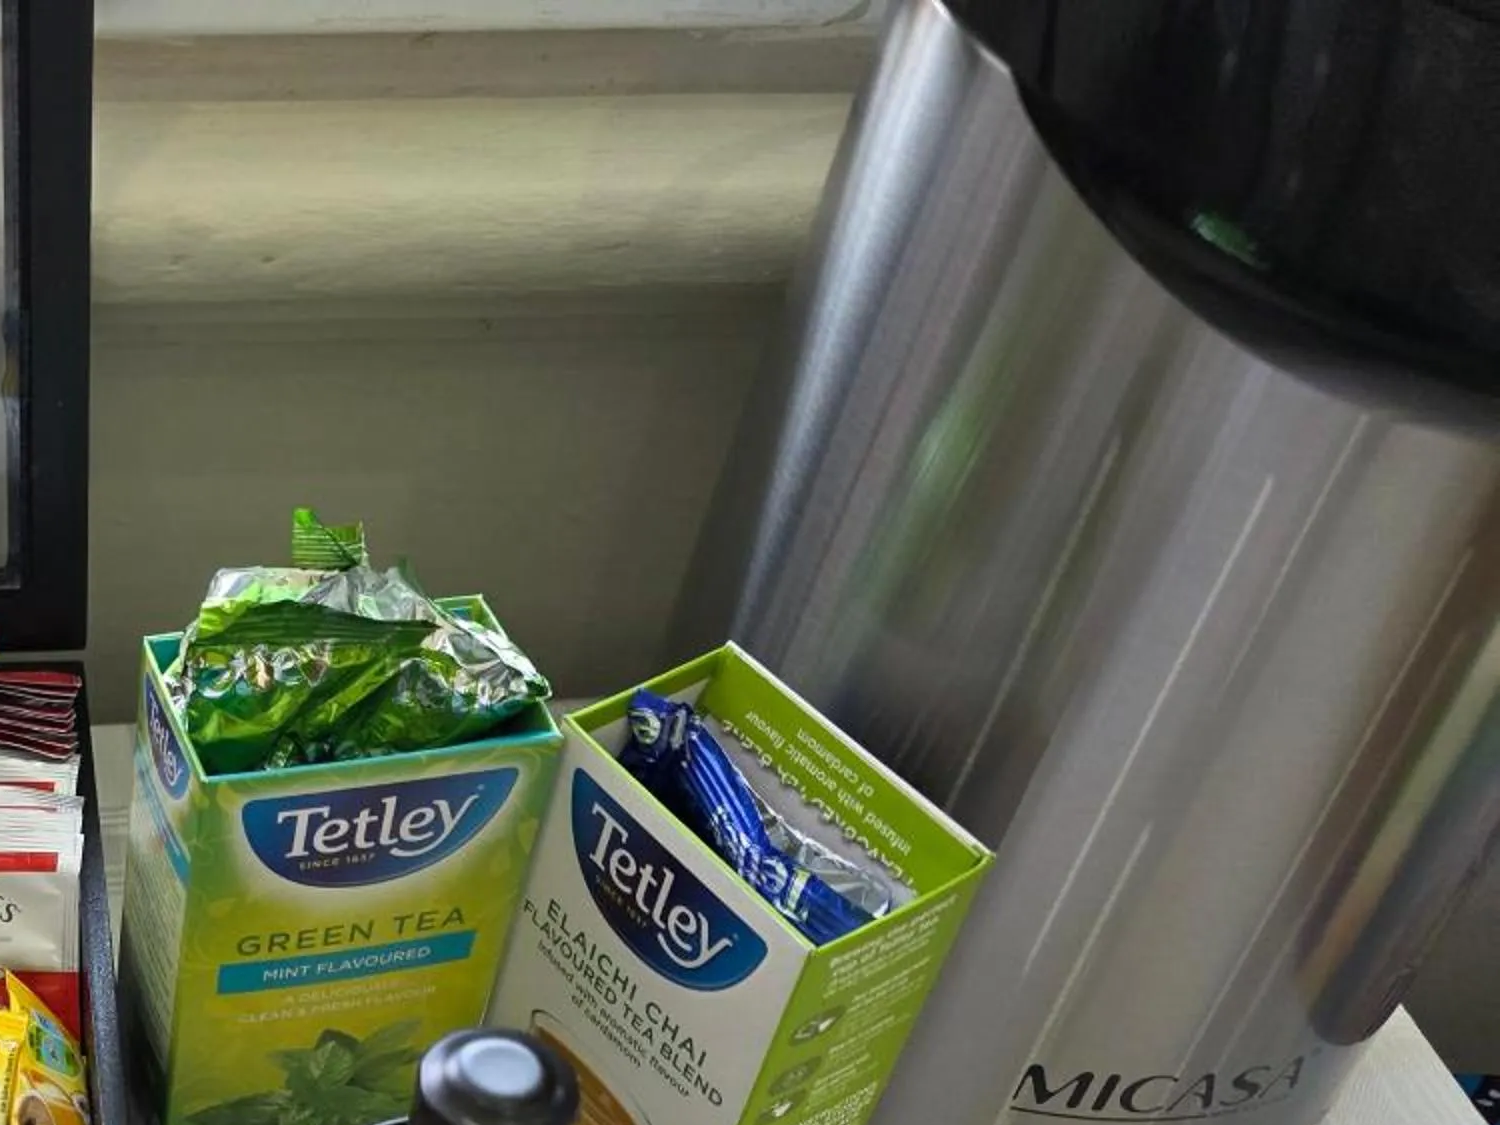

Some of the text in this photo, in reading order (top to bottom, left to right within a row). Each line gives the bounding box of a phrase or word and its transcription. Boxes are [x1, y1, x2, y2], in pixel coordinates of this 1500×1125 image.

[277, 794, 481, 859] Tetley
[589, 801, 734, 969] Tetley
[237, 906, 465, 958] GREEN TEA
[262, 946, 432, 982] MINT FLAVOURED
[523, 899, 723, 1107] FLAVOURED TEA BLEND
[547, 898, 637, 1000] ELAICHI
[645, 1002, 706, 1068] CHAI
[1011, 1055, 1307, 1114] MICASA
